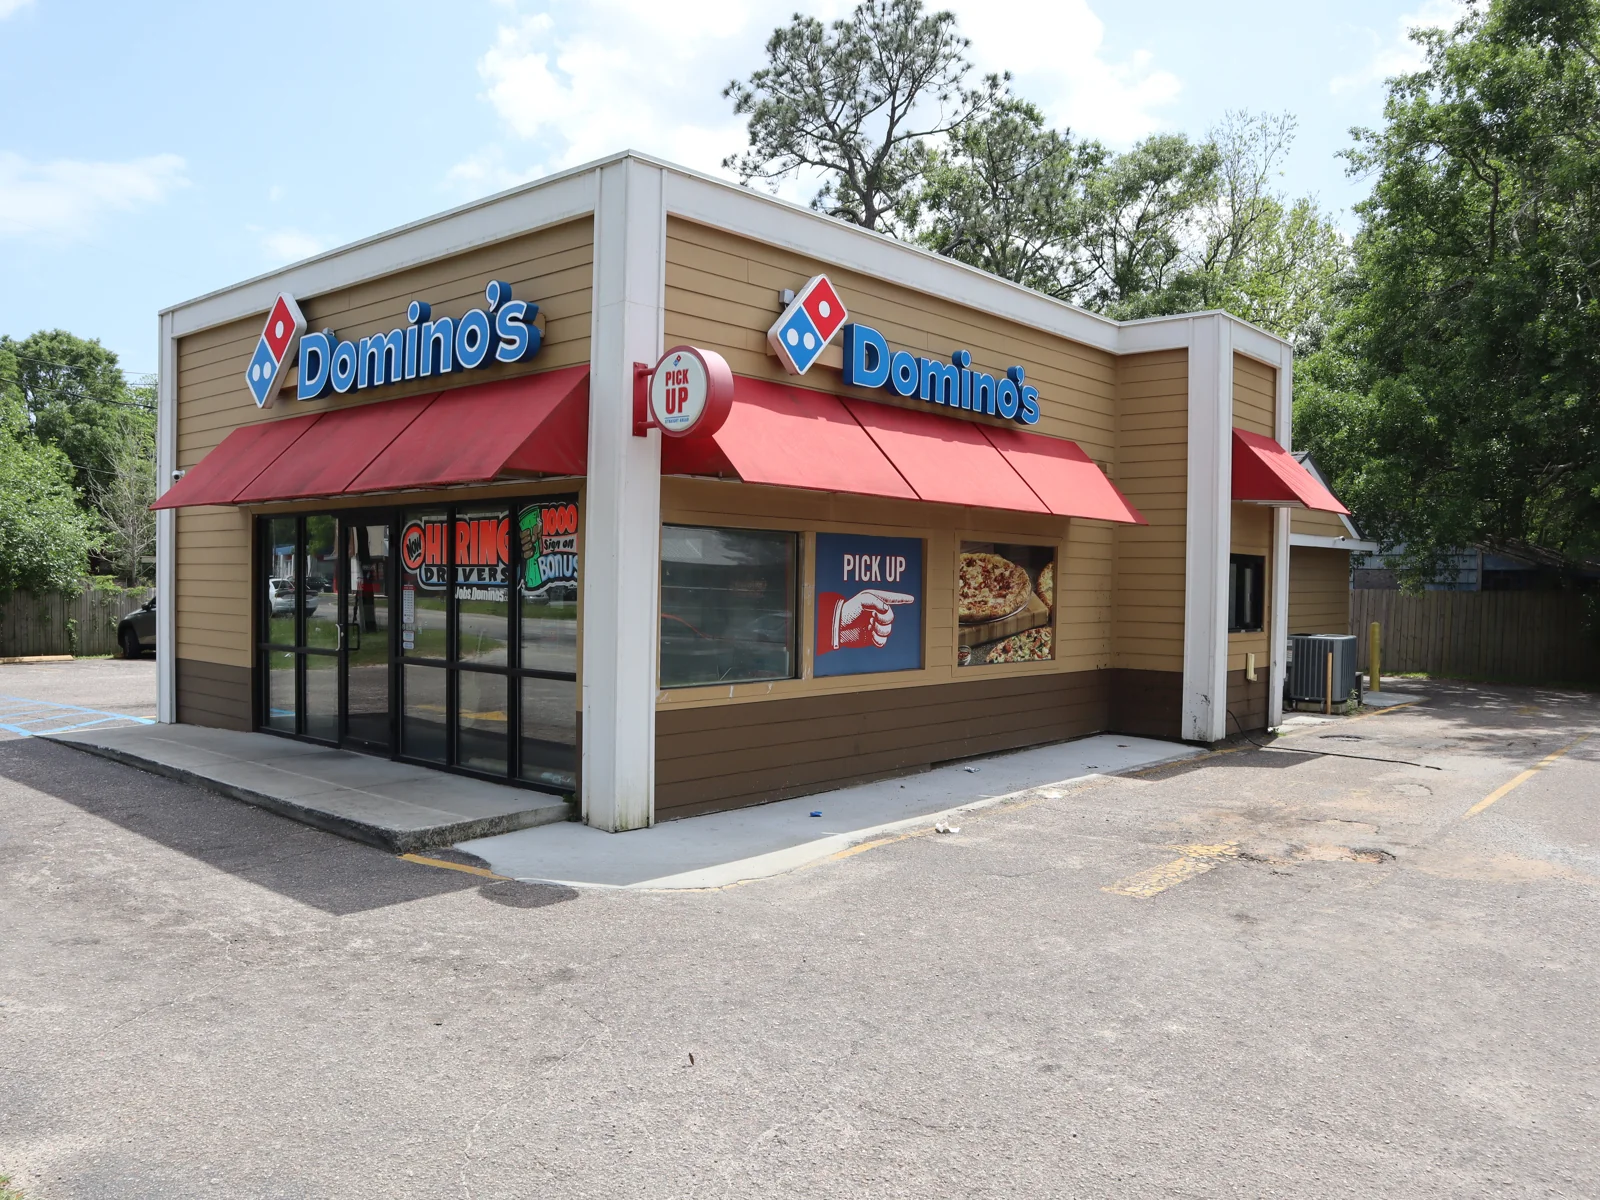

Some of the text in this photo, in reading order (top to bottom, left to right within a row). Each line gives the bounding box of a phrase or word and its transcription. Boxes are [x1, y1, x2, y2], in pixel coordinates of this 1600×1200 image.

[297, 279, 536, 401] Domino's
[665, 369, 689, 387] PICK
[845, 322, 1041, 425] Domino's
[665, 387, 689, 415] UP
[843, 554, 906, 582] PICK UP
